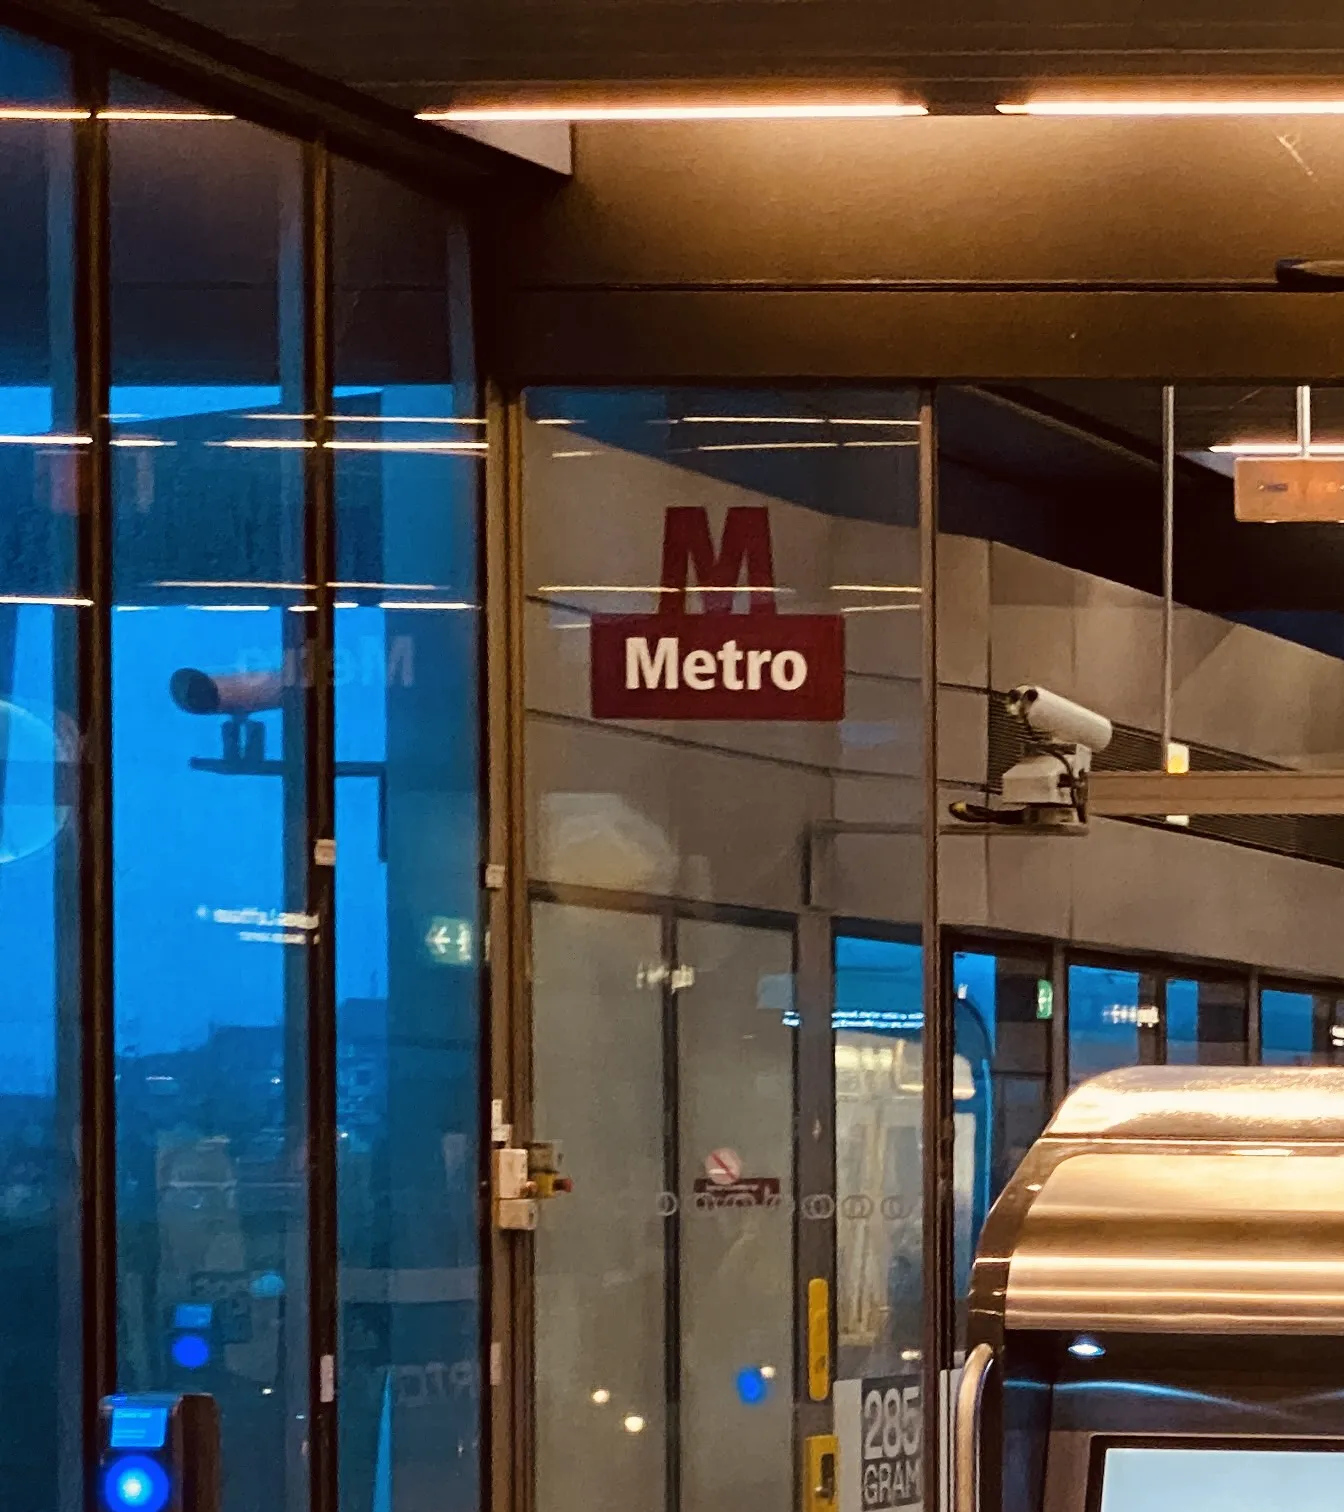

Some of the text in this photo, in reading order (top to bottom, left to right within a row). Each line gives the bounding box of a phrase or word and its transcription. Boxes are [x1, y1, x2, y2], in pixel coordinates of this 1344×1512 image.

[658, 506, 777, 614] M
[625, 637, 808, 691] Metro
[864, 1387, 922, 1459] 285
[863, 1459, 922, 1506] GRAM
